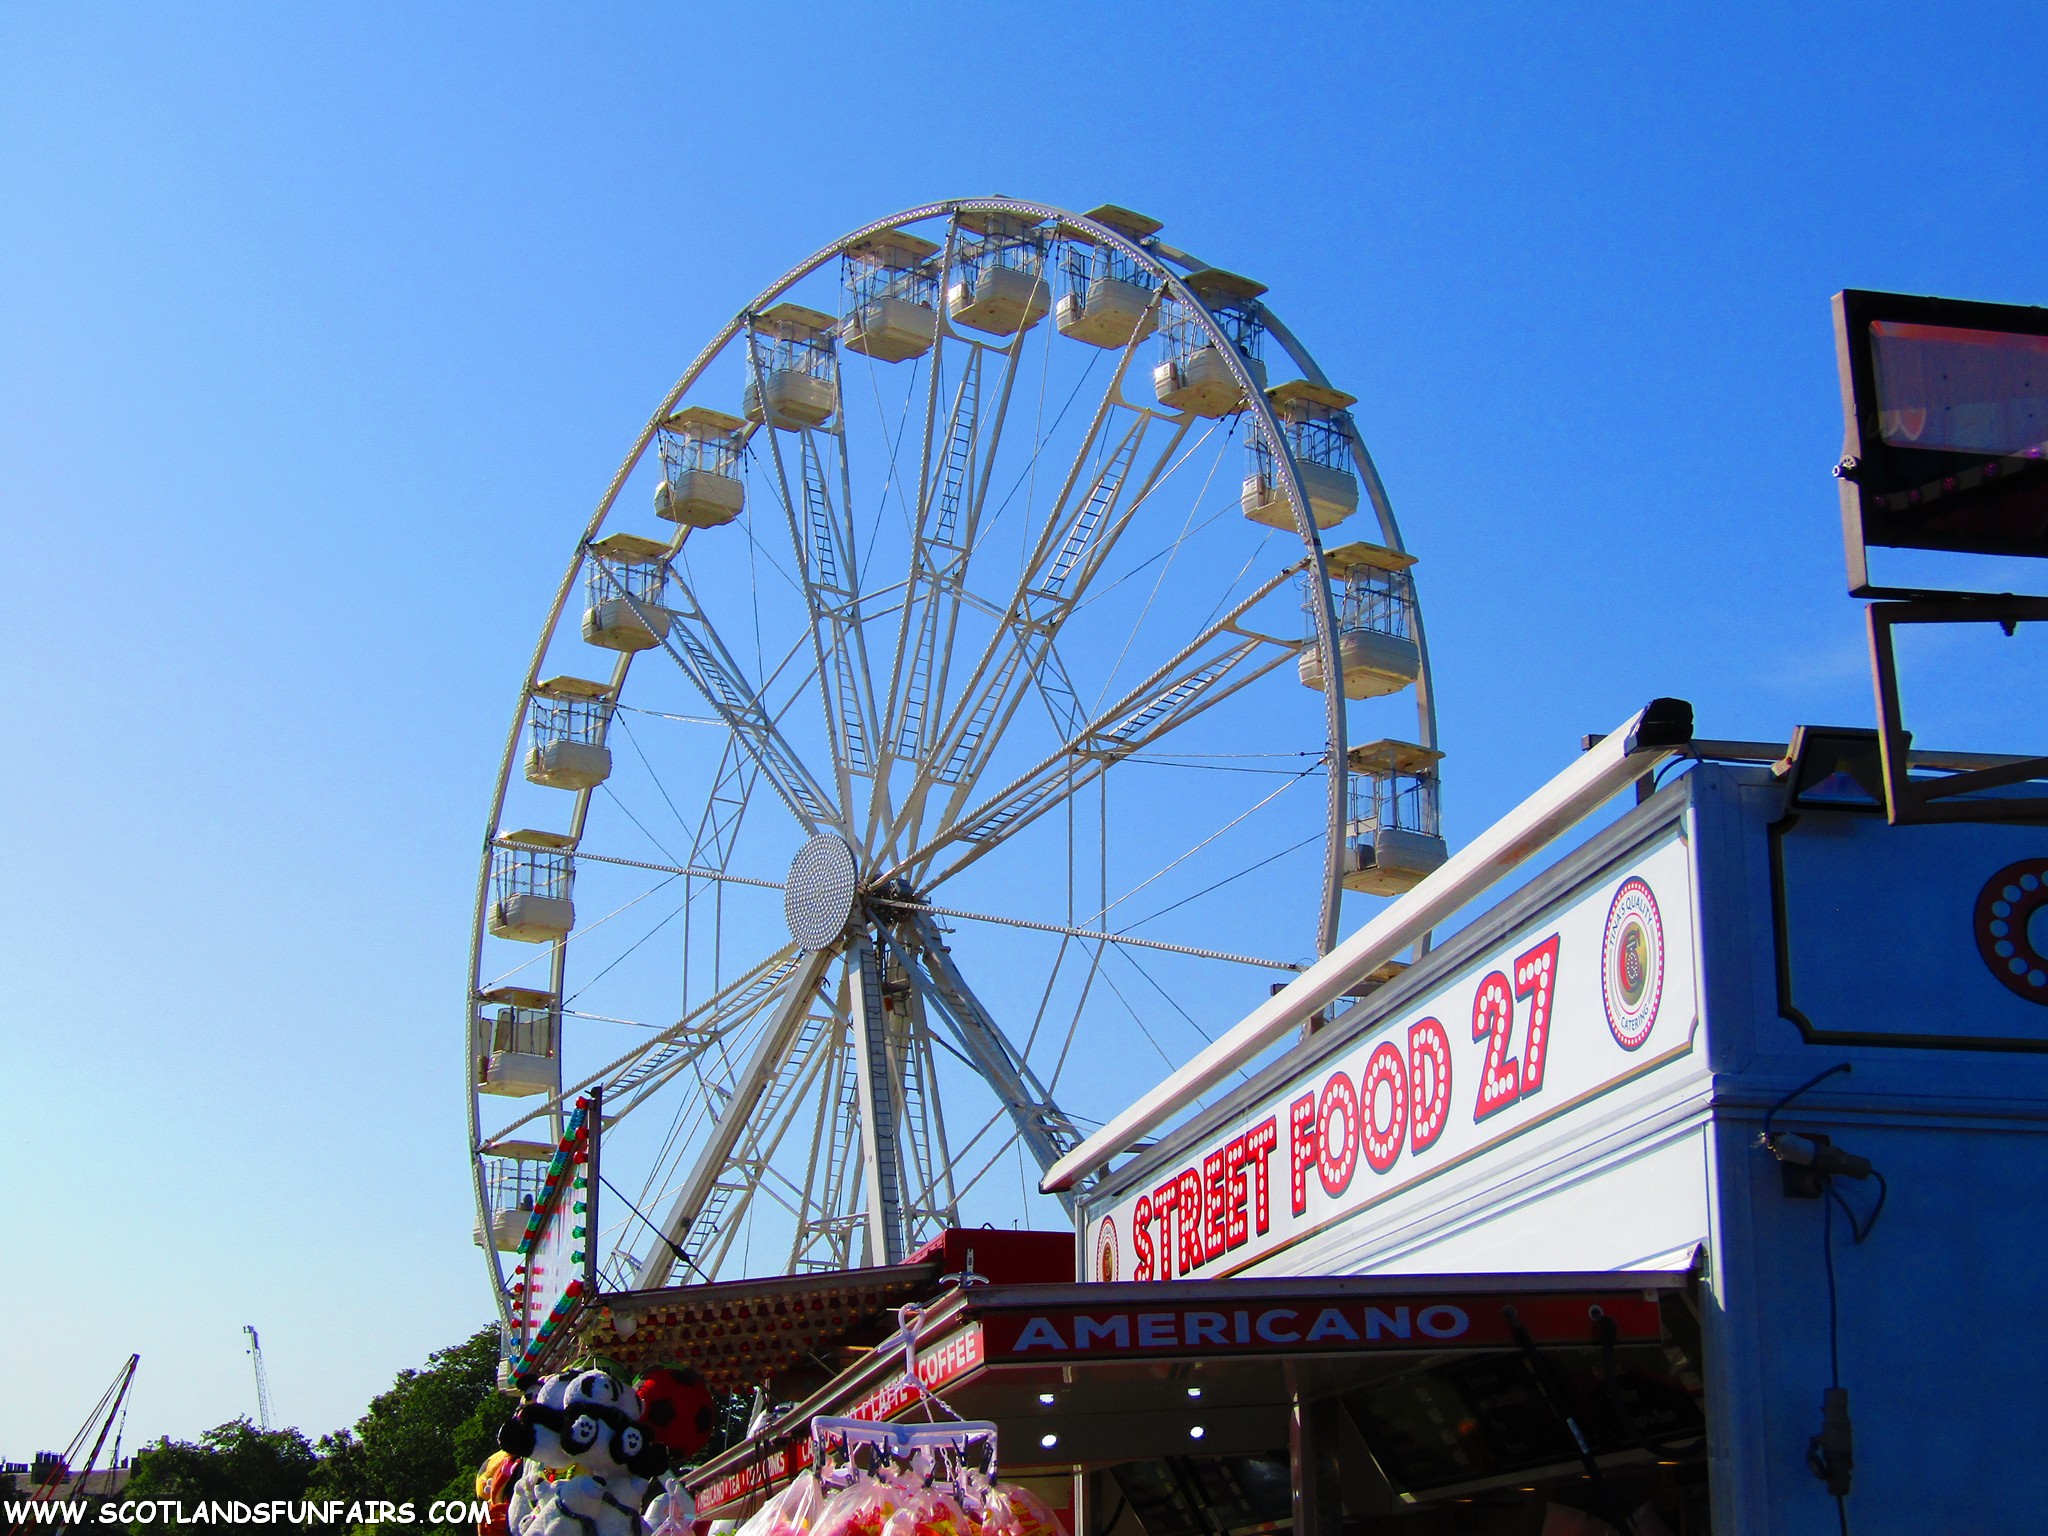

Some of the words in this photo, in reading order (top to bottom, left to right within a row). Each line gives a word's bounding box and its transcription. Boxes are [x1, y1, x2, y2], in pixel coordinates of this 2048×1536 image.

[1608, 903, 1625, 950] TINA'S
[1625, 895, 1653, 925] QUALITY
[1620, 1003, 1649, 1031] CATERING
[1132, 1114, 1278, 1281] STREET
[1289, 1016, 1453, 1219] FOOD
[1471, 932, 1561, 1125] 27
[1012, 1305, 1470, 1352] AMERICANO
[918, 1329, 976, 1387] COFFEE
[728, 1473, 741, 1497] TEA
